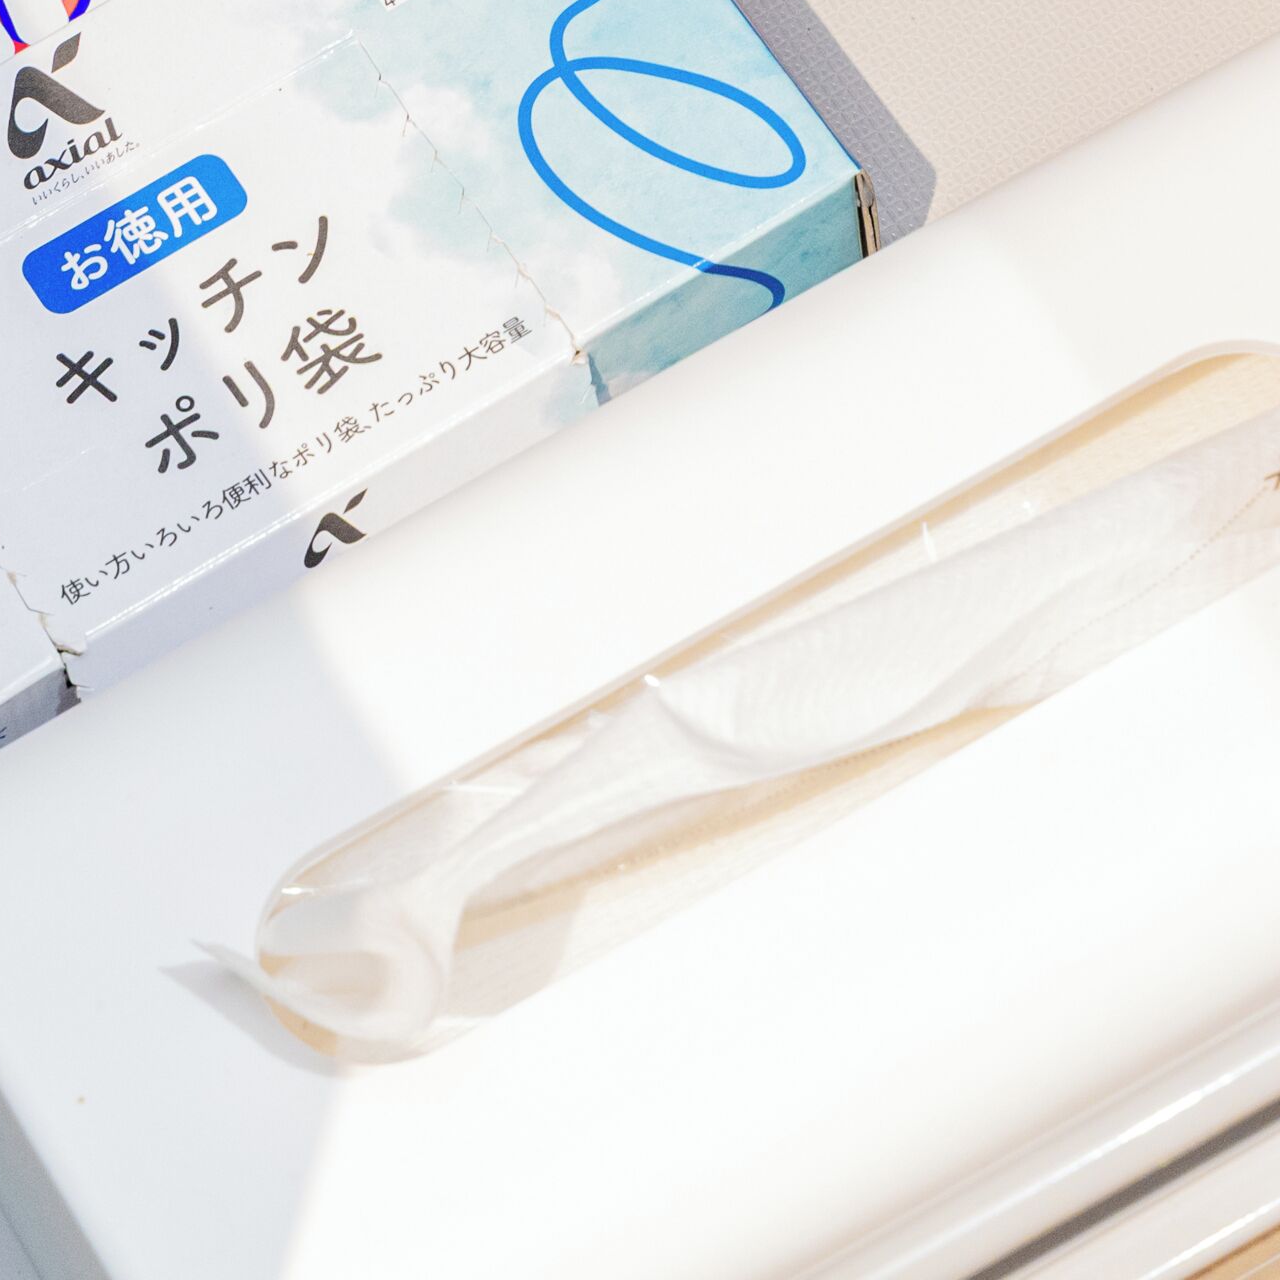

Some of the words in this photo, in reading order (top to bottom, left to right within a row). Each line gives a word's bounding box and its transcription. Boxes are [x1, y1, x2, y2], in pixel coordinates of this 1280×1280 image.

[23, 117, 123, 190] axial
[60, 174, 218, 290] お徳用
[55, 214, 330, 405] キッチン
[144, 307, 384, 474] ポリ袋
